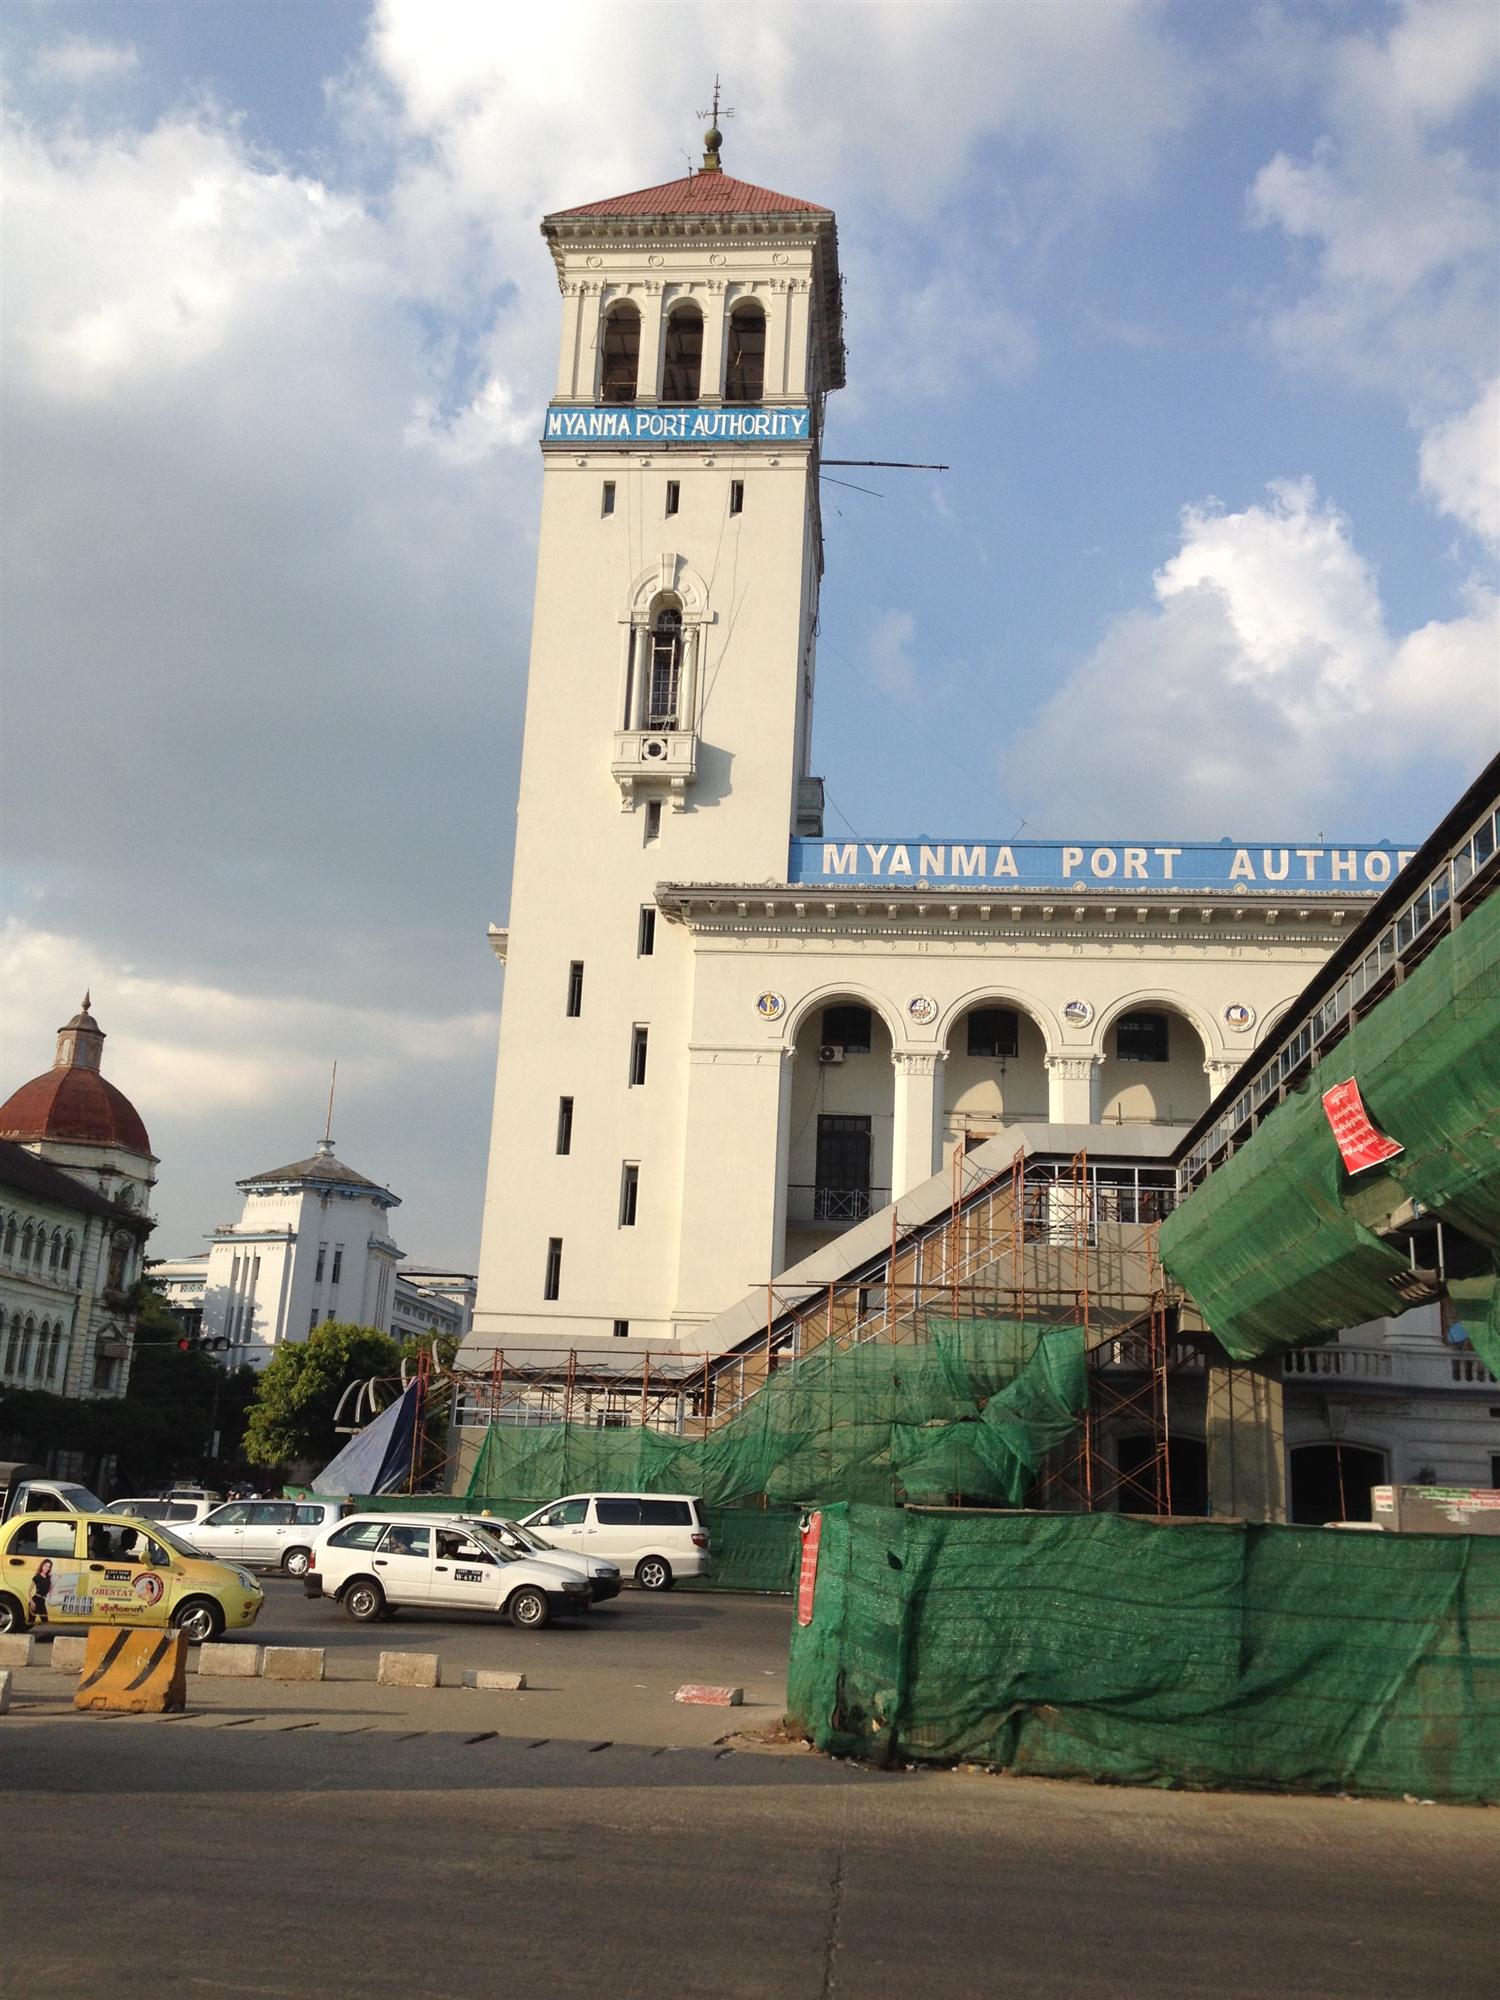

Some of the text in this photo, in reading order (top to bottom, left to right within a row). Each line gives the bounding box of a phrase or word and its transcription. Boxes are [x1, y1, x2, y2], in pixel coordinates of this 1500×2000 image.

[547, 413, 806, 436] MYANMA PORT AUTHORITY
[822, 843, 1019, 877] MYANMA
[1062, 847, 1182, 879] PORT
[91, 1587, 134, 1597] OBESTAT
